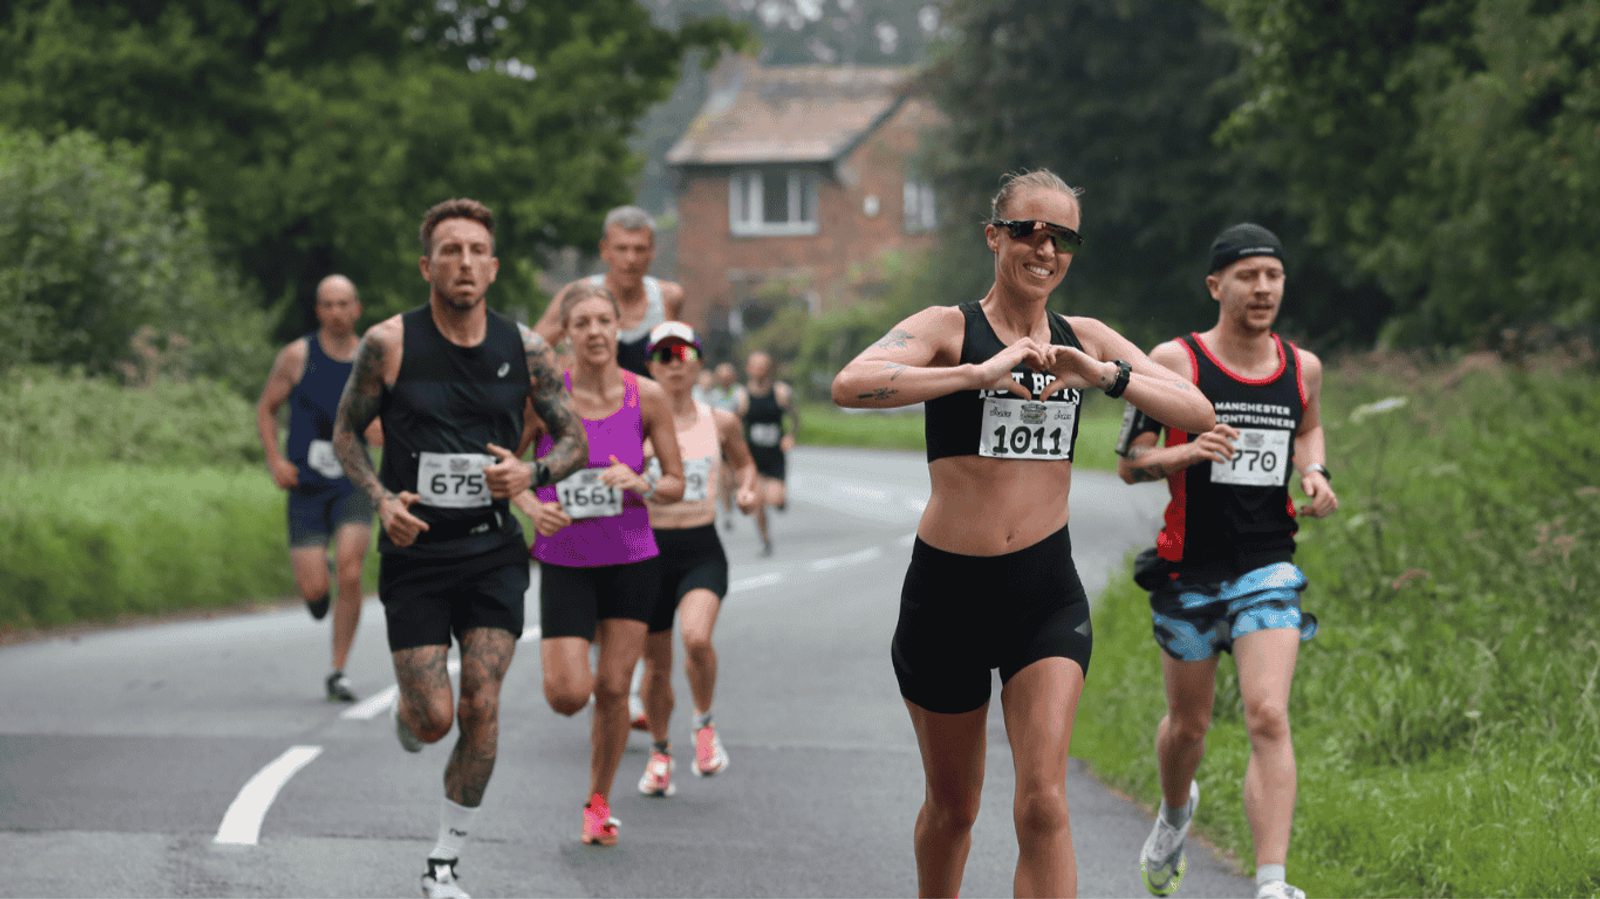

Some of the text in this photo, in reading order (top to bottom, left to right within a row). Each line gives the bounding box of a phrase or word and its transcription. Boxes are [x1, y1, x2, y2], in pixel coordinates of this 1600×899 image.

[1215, 402, 1290, 416] MANCHESTER
[1215, 413, 1296, 429] RONTRUNNERS
[993, 425, 1062, 455] 1011
[1231, 449, 1277, 472] 770
[431, 473, 483, 495] 675
[563, 486, 616, 507] 1661
